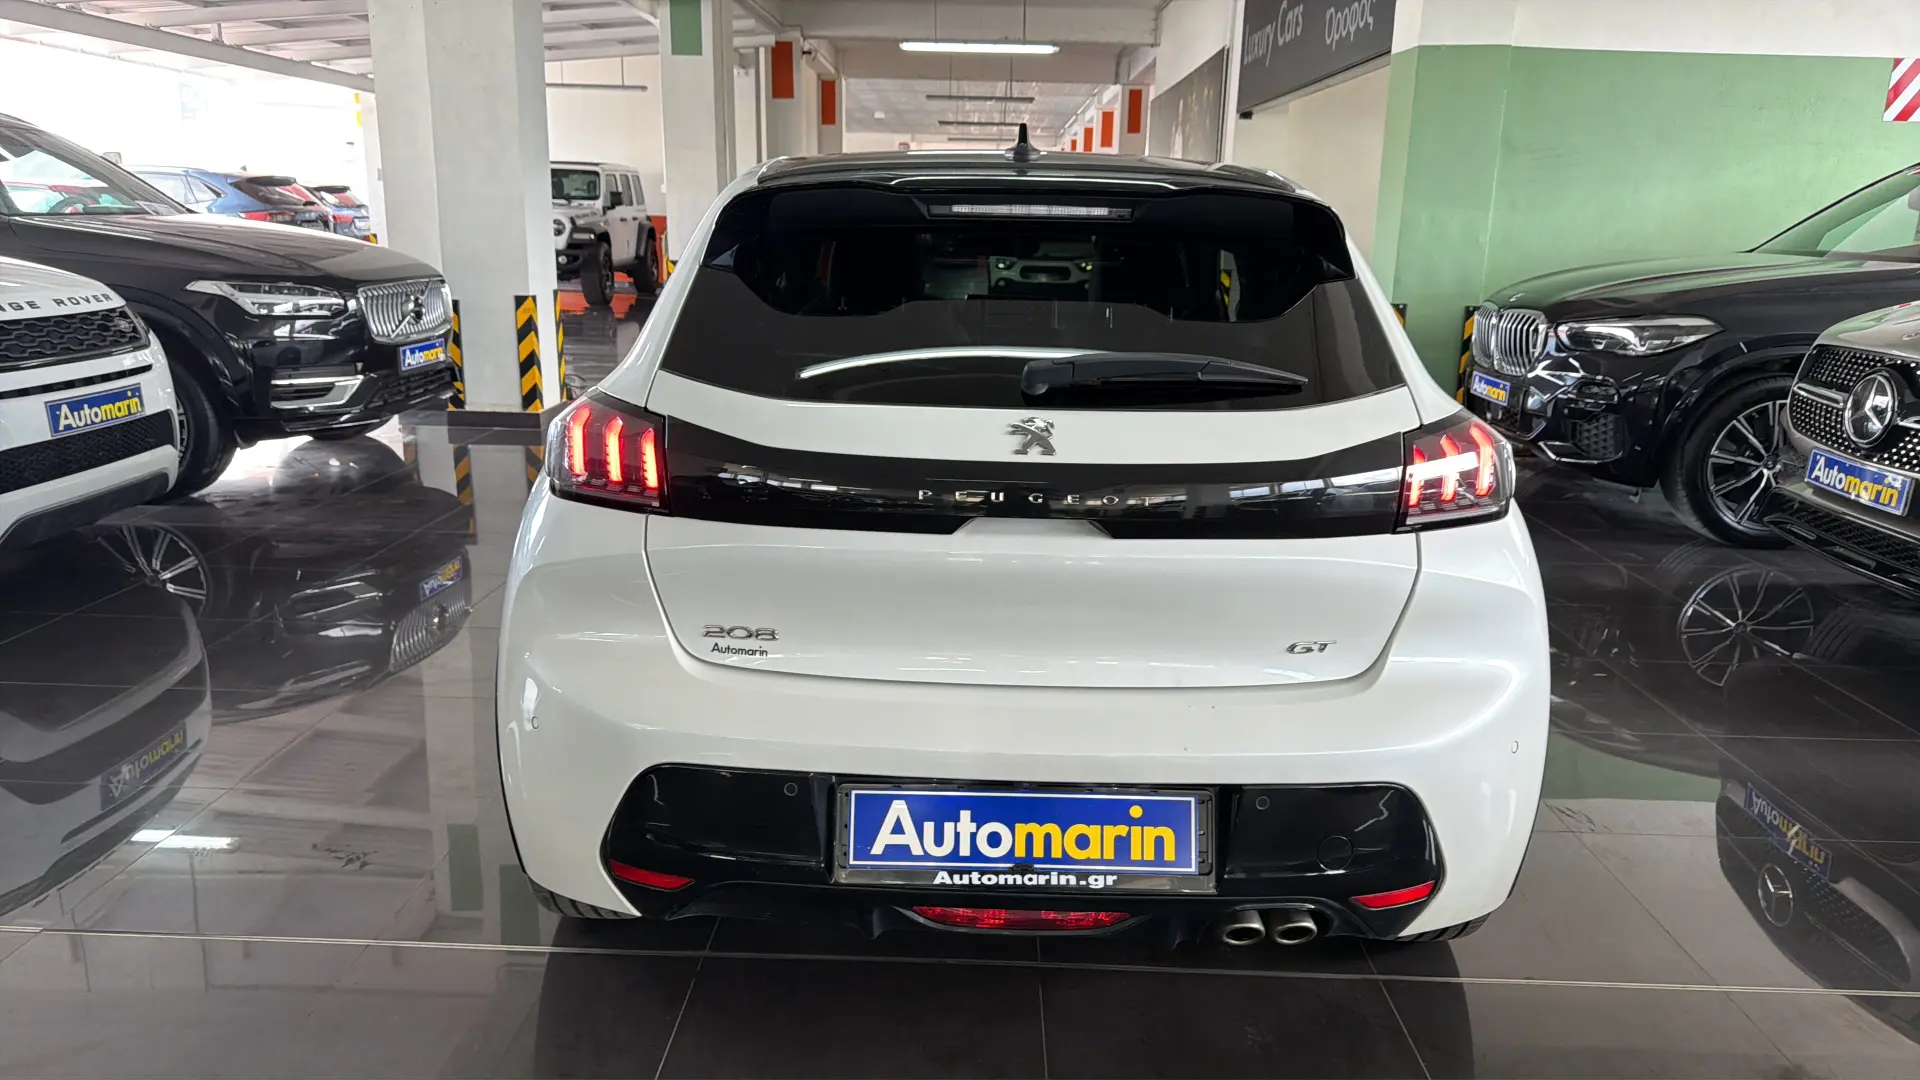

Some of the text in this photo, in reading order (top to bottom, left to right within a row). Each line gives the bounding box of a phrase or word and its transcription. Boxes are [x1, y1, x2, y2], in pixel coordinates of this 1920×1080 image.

[1243, 0, 1303, 66] Luxury Cars
[52, 293, 113, 307] ROVER
[58, 391, 142, 431] Automarin
[1811, 456, 1899, 507] Automarin
[918, 489, 1153, 507] PEUGEOT
[702, 624, 780, 641] 208
[711, 642, 768, 657] Automarin
[1286, 640, 1338, 655] GT
[870, 800, 1176, 862] Automarin
[933, 871, 1118, 889] Automarin.gr
